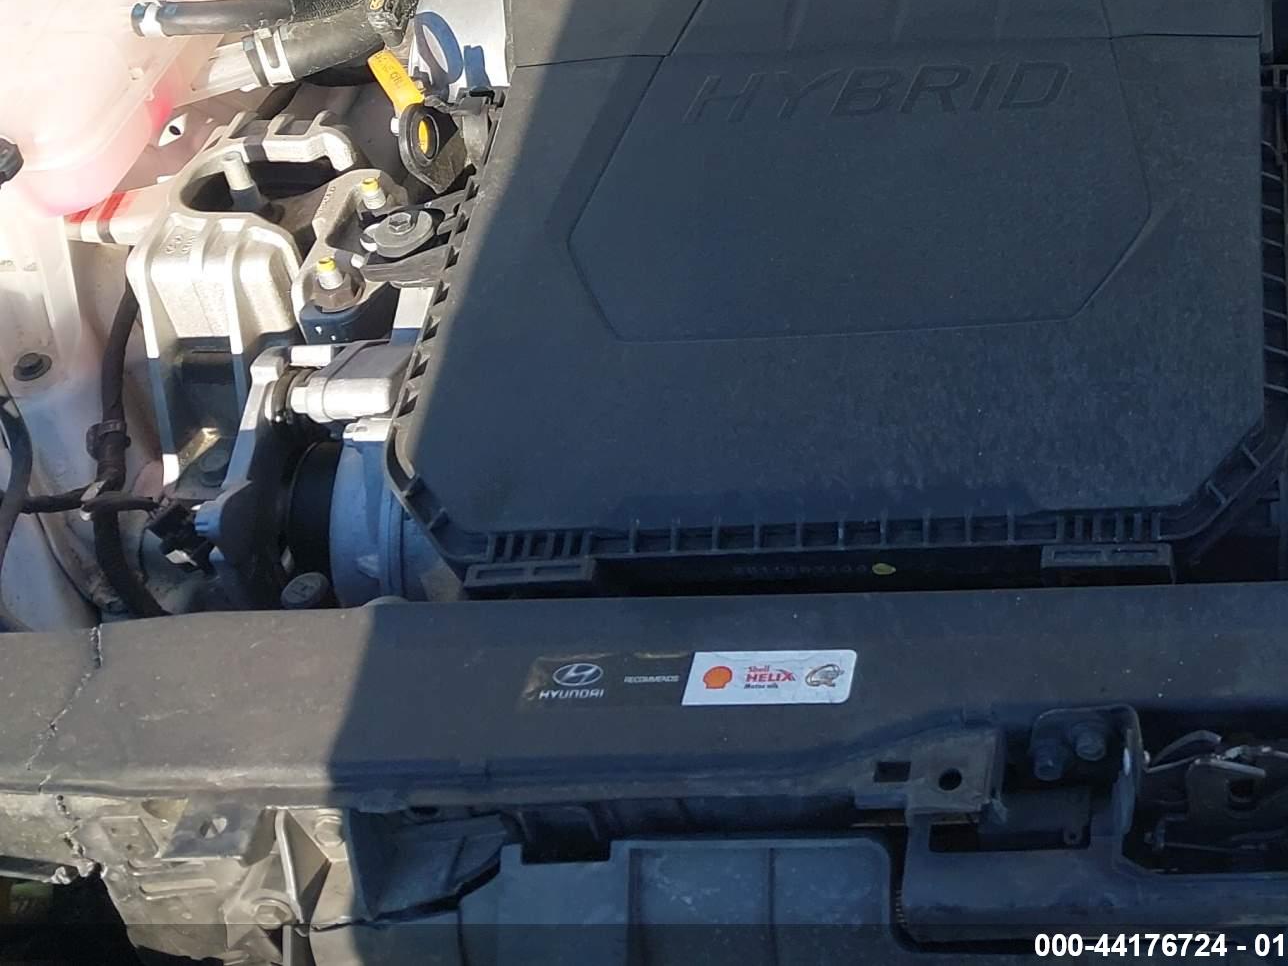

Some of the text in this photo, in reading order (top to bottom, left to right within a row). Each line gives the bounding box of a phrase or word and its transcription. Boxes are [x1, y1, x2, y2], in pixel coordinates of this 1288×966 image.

[680, 59, 1072, 123] HYBRID
[744, 670, 796, 683] HELIX
[539, 688, 604, 700] HYUNDAI
